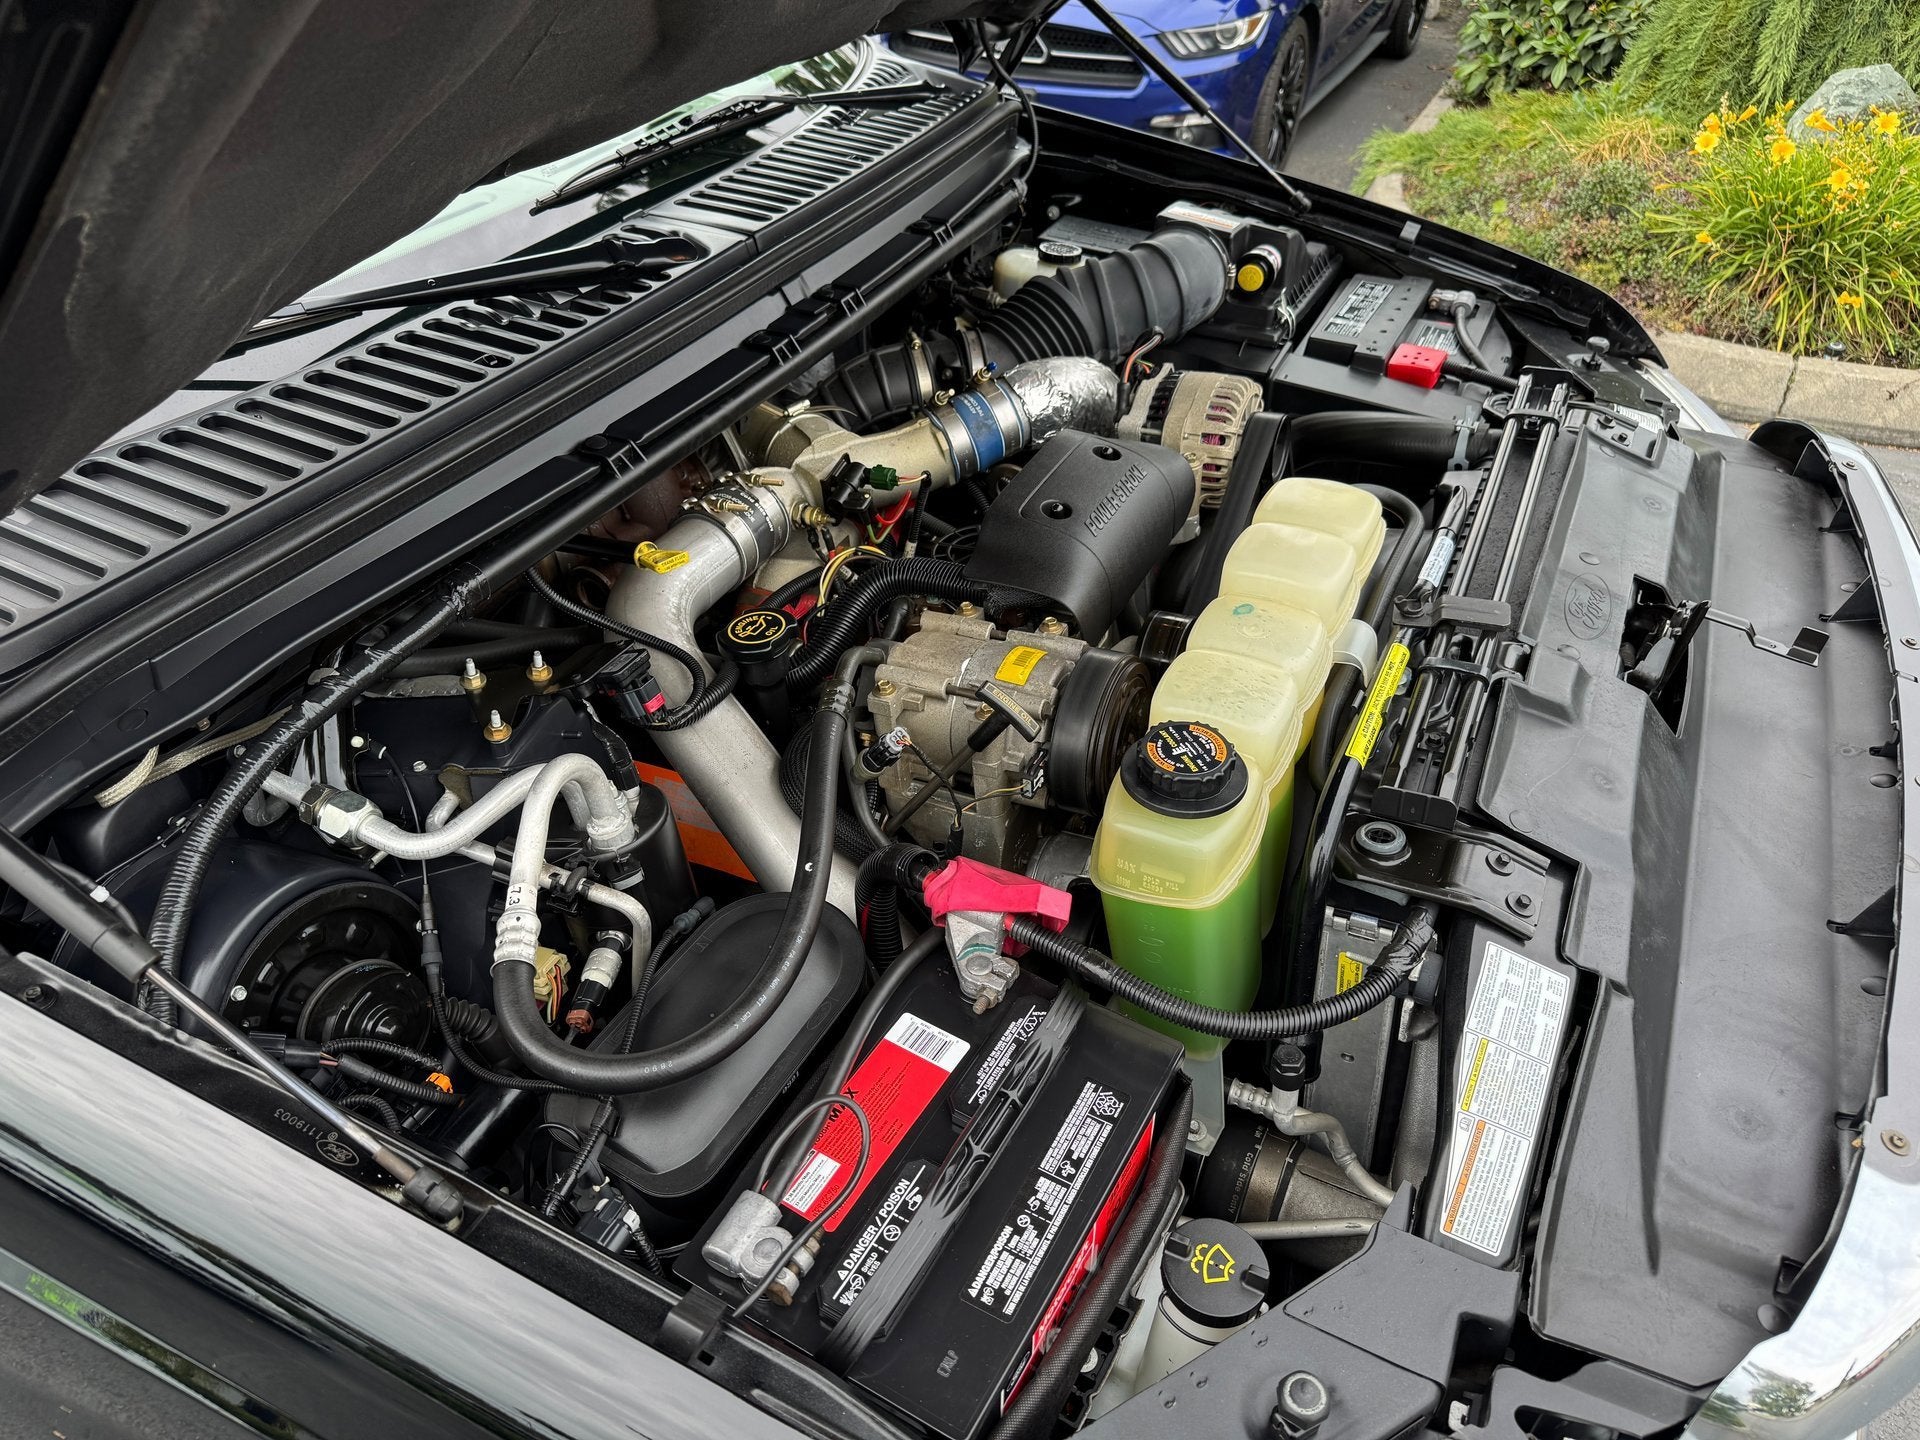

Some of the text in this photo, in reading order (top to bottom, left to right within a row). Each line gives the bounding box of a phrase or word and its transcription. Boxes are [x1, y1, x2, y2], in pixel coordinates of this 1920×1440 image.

[734, 615, 758, 633] ENGINE
[765, 626, 778, 636] OIL
[991, 688, 1032, 725] ENGINE OIL
[1464, 1083, 1473, 1101] CAUTION
[1464, 1127, 1482, 1172] AVERTISSEMENT
[1240, 1151, 1253, 1170] Cold
[1233, 1172, 1246, 1191] Side
[1449, 1191, 1463, 1219] WARNING
[842, 1223, 879, 1270] DANGER
[878, 1178, 911, 1218] POISON
[860, 1250, 879, 1273] SHIELD
[970, 1224, 1013, 1290] DANGER/POISON
[866, 1259, 881, 1277] EYES
